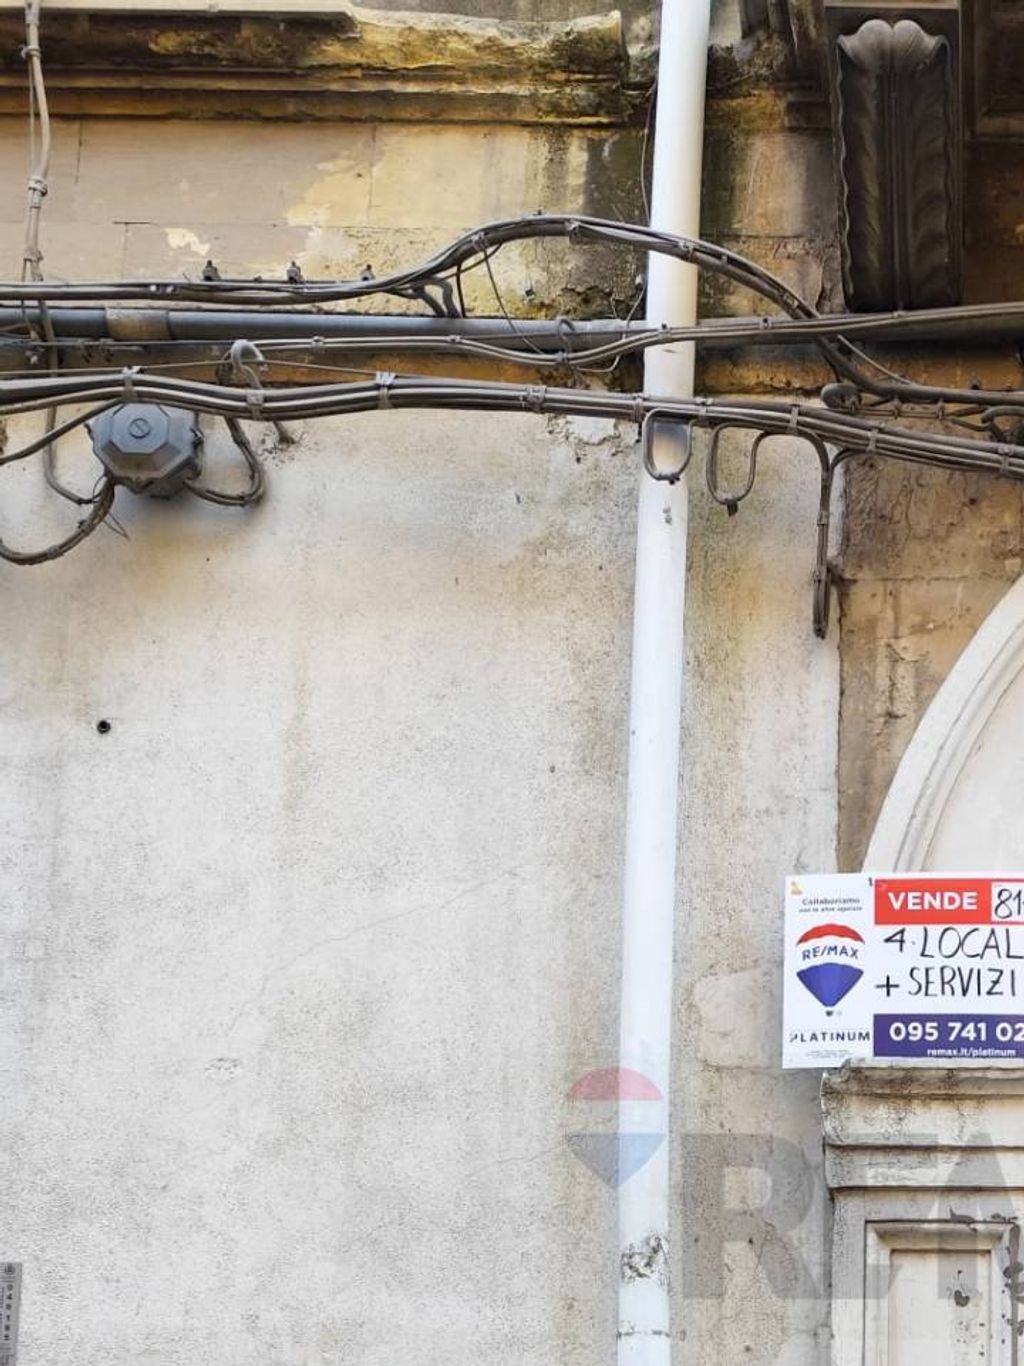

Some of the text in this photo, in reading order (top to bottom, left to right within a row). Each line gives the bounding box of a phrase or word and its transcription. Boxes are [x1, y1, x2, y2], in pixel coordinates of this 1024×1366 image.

[888, 892, 978, 910] VENDE
[802, 944, 859, 961] RE/MAX
[907, 965, 1016, 998] SERVIZI
[889, 1021, 939, 1042] 095
[948, 1021, 987, 1042] 741
